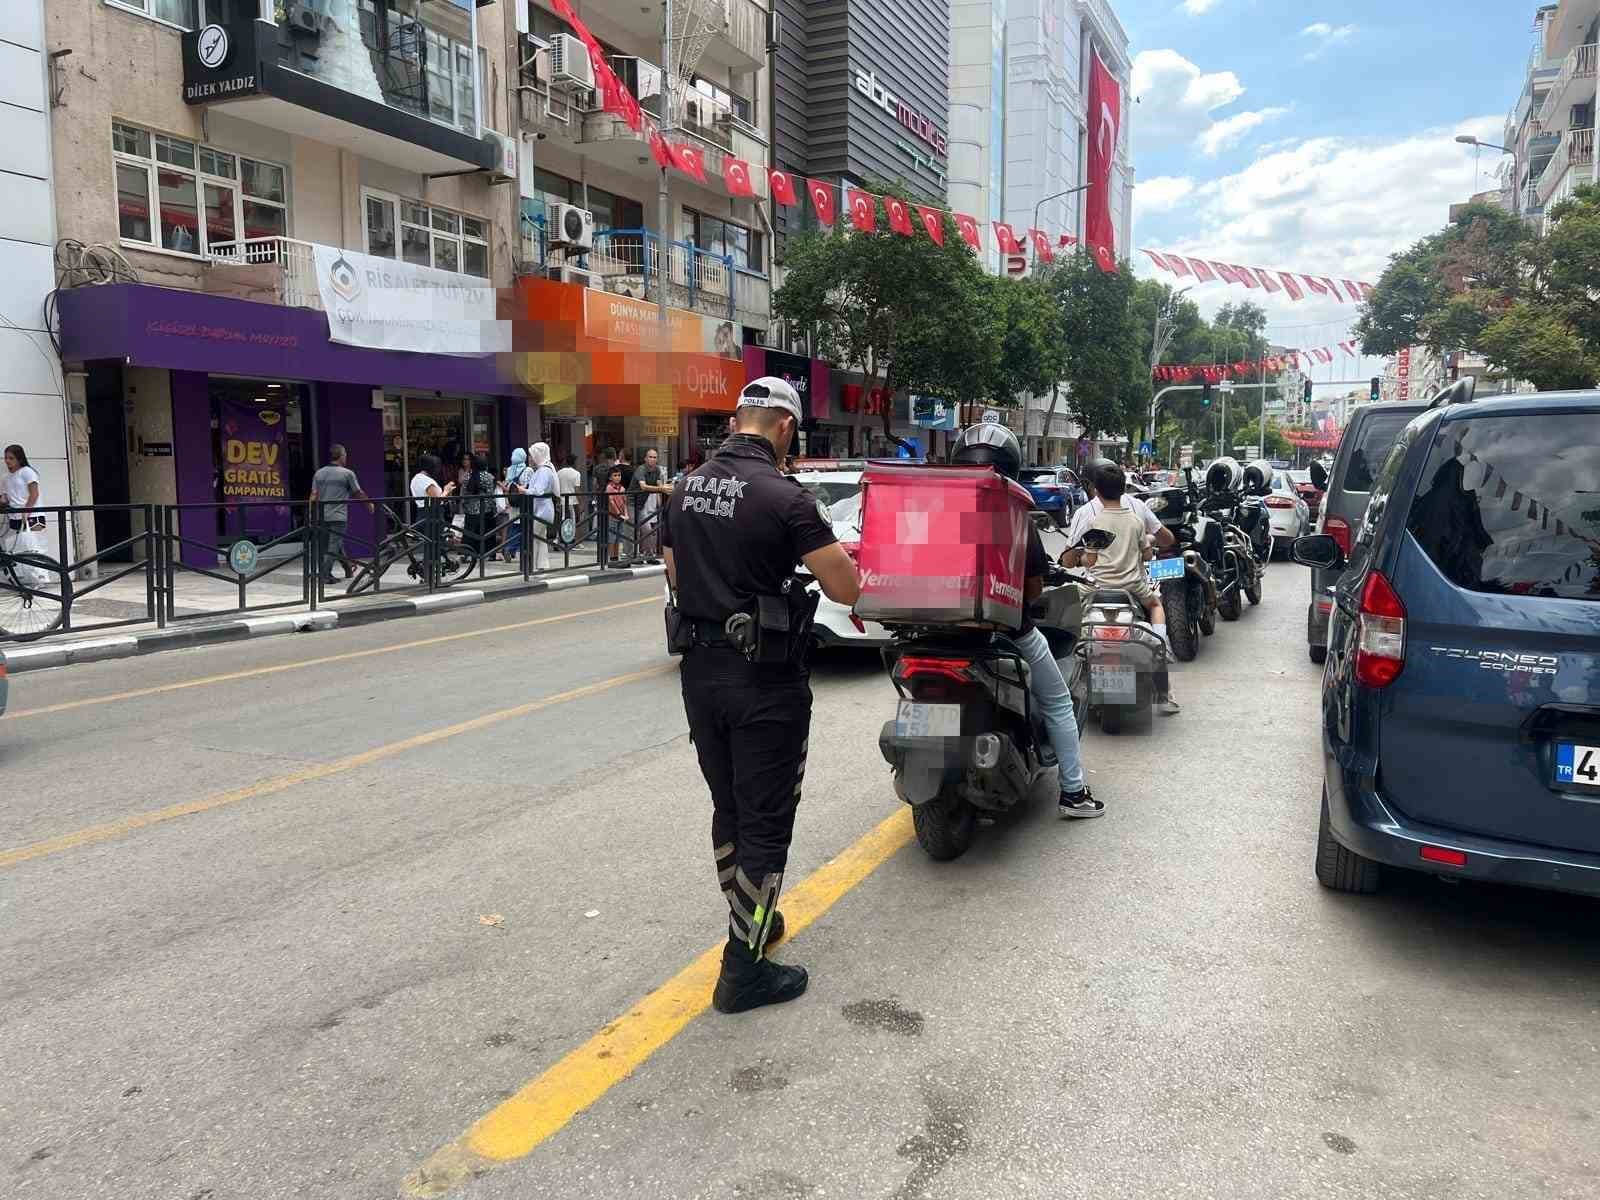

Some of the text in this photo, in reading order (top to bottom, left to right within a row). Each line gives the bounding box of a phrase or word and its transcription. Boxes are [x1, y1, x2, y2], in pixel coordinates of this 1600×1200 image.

[187, 75, 255, 98] DİLEK YALDIZ
[687, 366, 728, 398] Optik
[227, 440, 279, 465] DEV
[224, 467, 281, 485] GRATİS
[685, 475, 748, 498] TRAFİK
[682, 495, 736, 518] POLİSİ
[1430, 647, 1558, 666] TOURNEO
[1479, 662, 1558, 675] COURIER
[1558, 765, 1573, 775] TR
